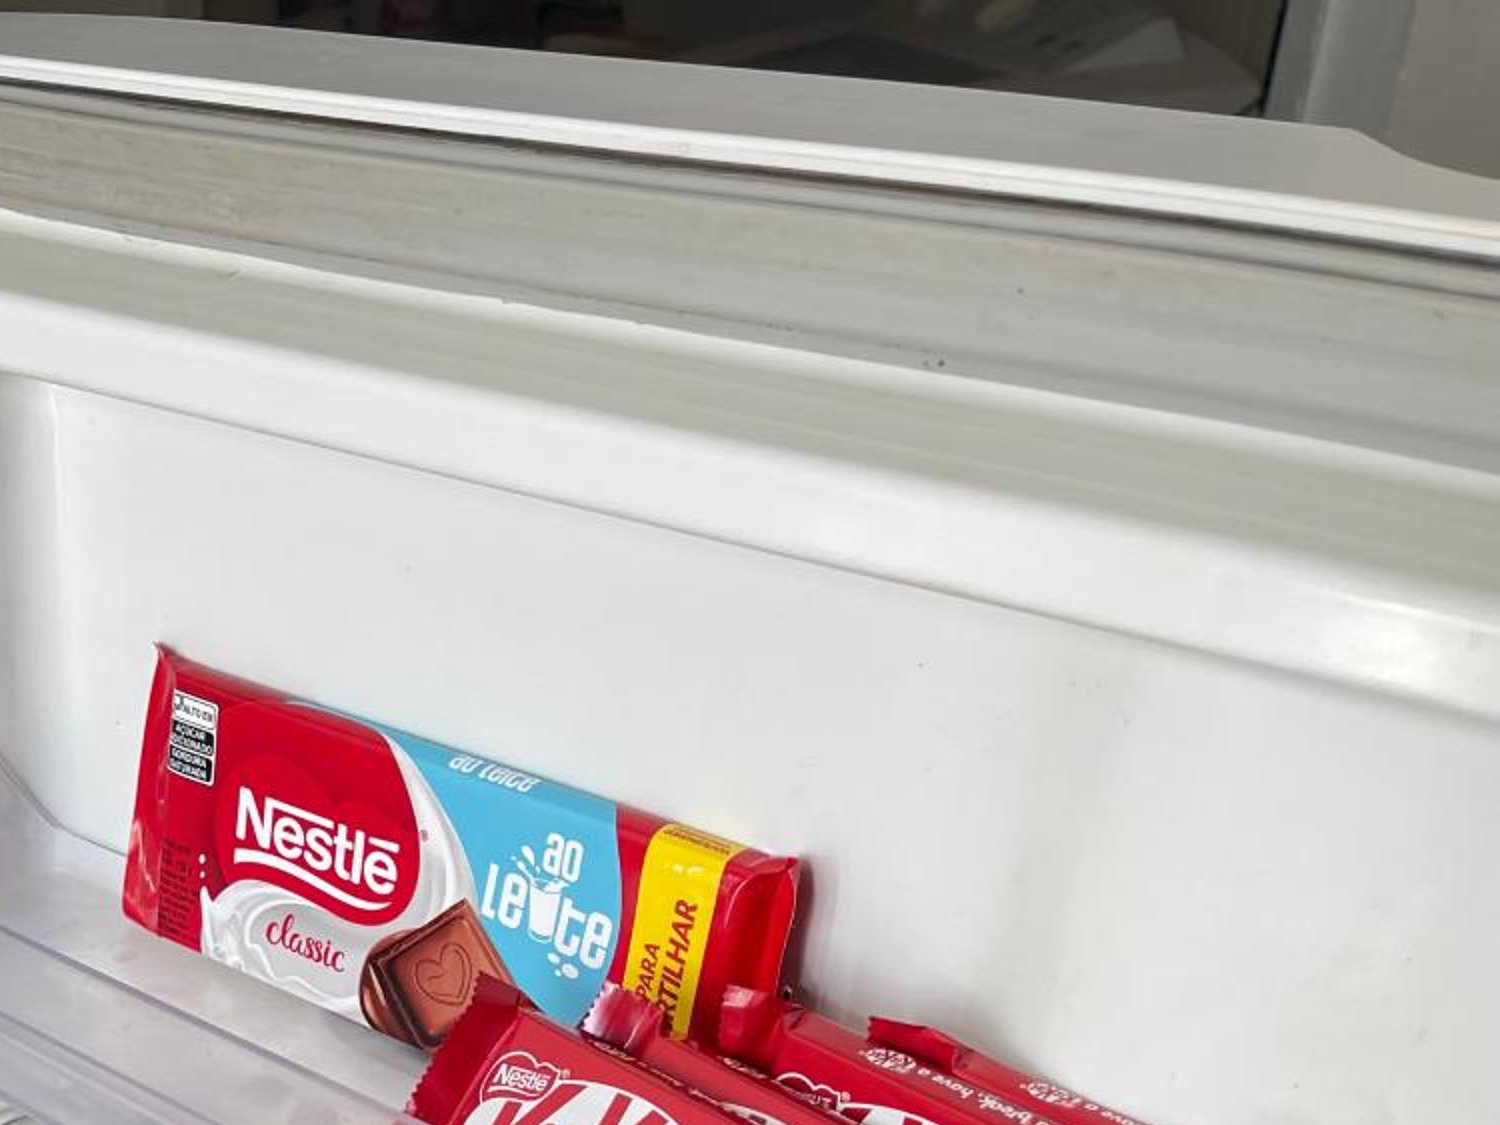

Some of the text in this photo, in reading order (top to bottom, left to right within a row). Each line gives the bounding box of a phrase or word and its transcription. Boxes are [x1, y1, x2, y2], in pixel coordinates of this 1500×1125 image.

[235, 785, 400, 896] Nestlé
[542, 832, 585, 883] ao
[266, 912, 347, 973] classic
[635, 941, 661, 1002] PARA
[655, 898, 698, 1020] RTILHAR
